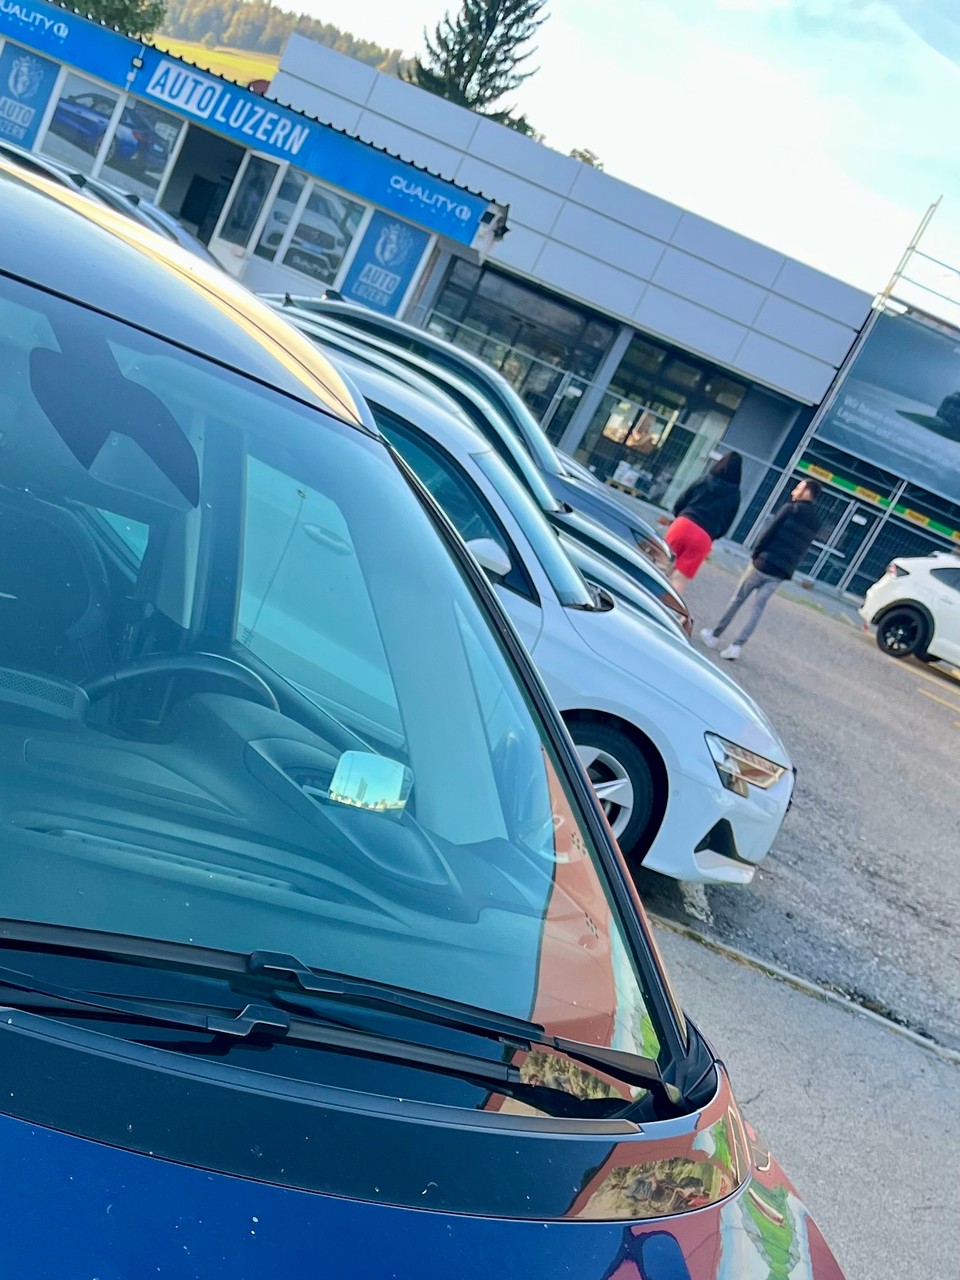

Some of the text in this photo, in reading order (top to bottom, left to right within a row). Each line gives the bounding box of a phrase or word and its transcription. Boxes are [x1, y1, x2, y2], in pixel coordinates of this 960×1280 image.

[151, 66, 311, 155] AUTO LUZERN
[362, 267, 399, 292] AUTO
